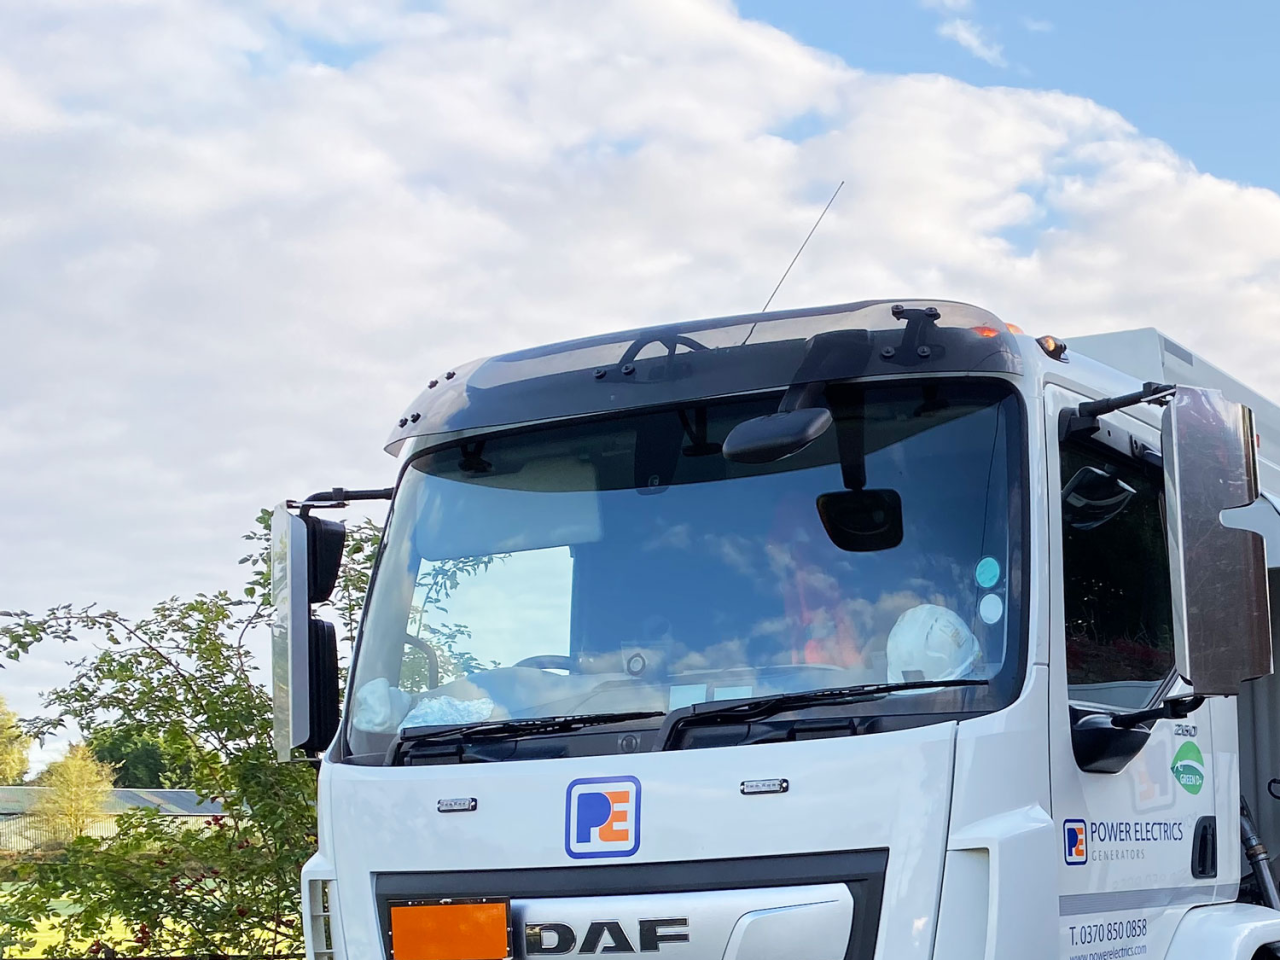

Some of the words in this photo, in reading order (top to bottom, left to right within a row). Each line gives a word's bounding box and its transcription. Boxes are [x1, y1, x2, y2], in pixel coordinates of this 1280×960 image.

[1091, 822, 1132, 842] POWER
[1134, 822, 1183, 841] ELECTRICS
[1092, 848, 1145, 861] GENERATORS
[525, 917, 690, 954] DAF
[1069, 926, 1078, 945] T.
[1080, 924, 1104, 944] 0370
[1107, 922, 1124, 941] 850
[1126, 919, 1147, 938] 0858
